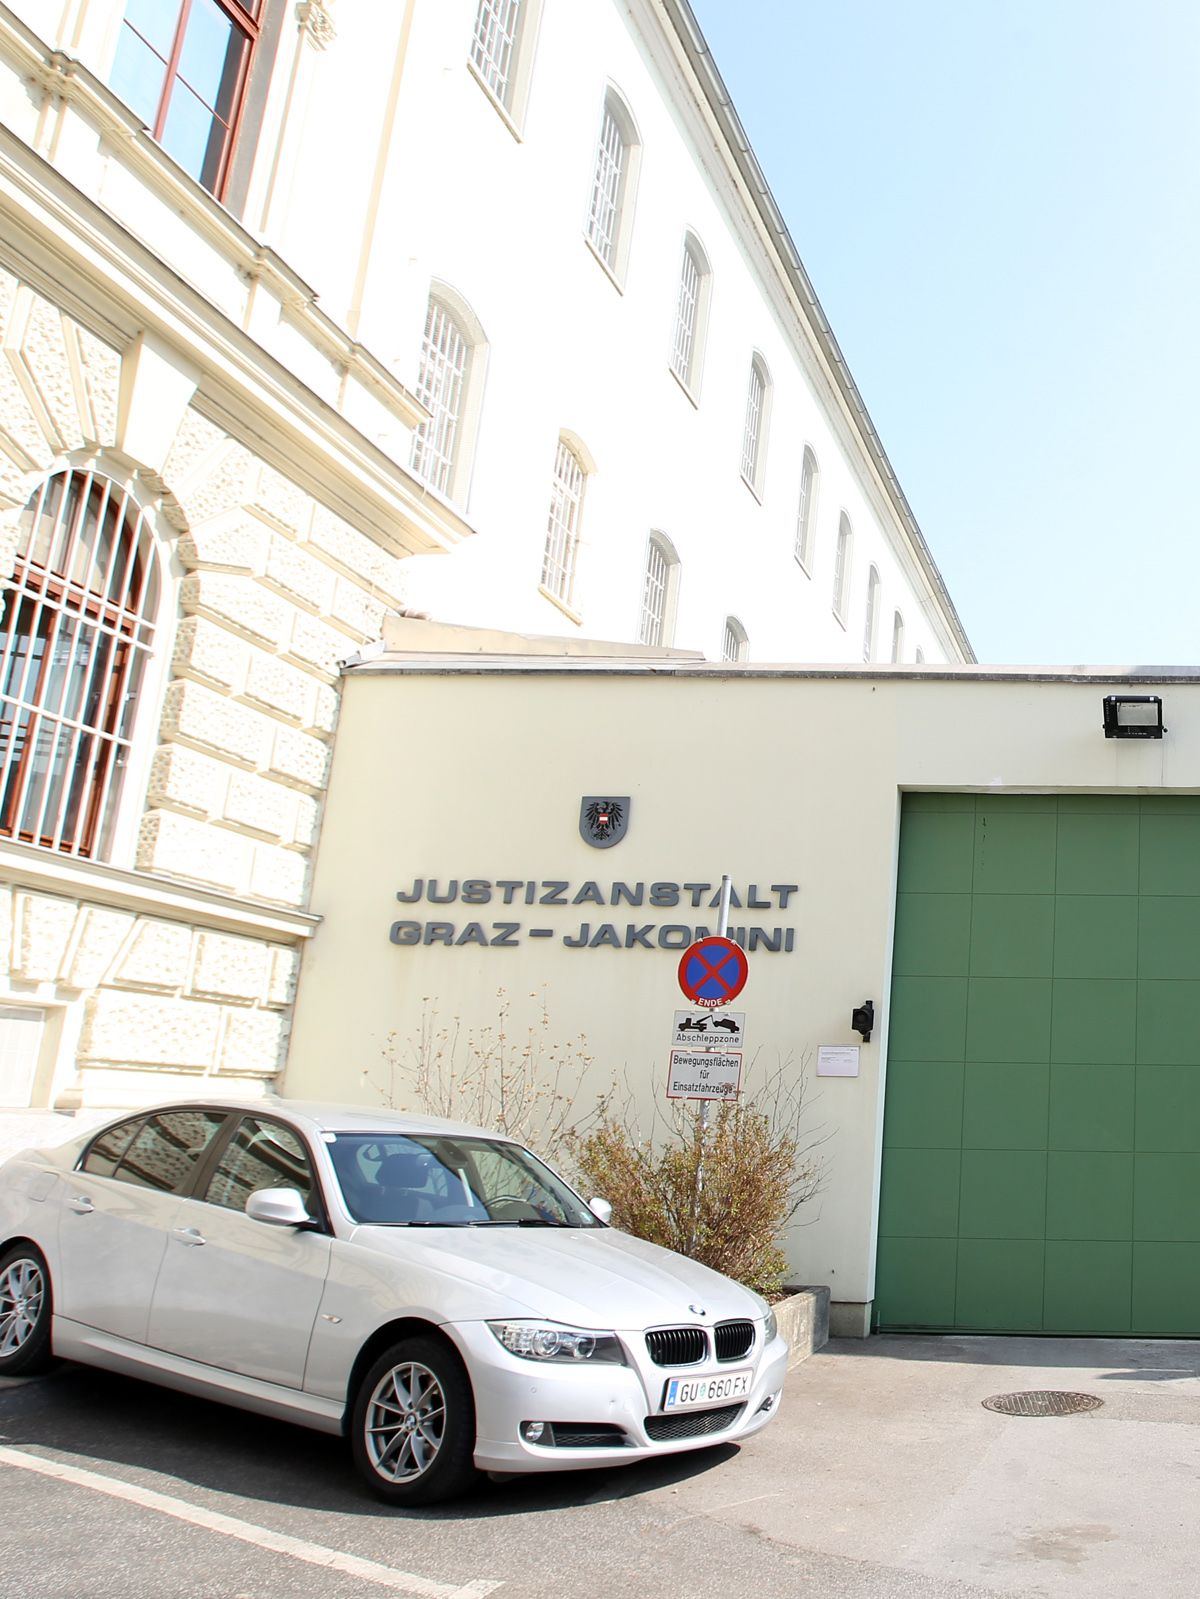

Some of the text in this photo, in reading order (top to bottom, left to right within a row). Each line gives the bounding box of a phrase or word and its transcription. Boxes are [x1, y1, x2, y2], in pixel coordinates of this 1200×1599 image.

[396, 879, 799, 909] JUSTIZANSTALT
[697, 998, 723, 1007] ENDE
[676, 1033, 740, 1044] Abschleppzone
[673, 1054, 739, 1068] Bewegungsflächen
[699, 1070, 710, 1080] für
[672, 1081, 734, 1096] Einsatzfahrzeuge
[680, 1376, 749, 1402] GU 660 FX
